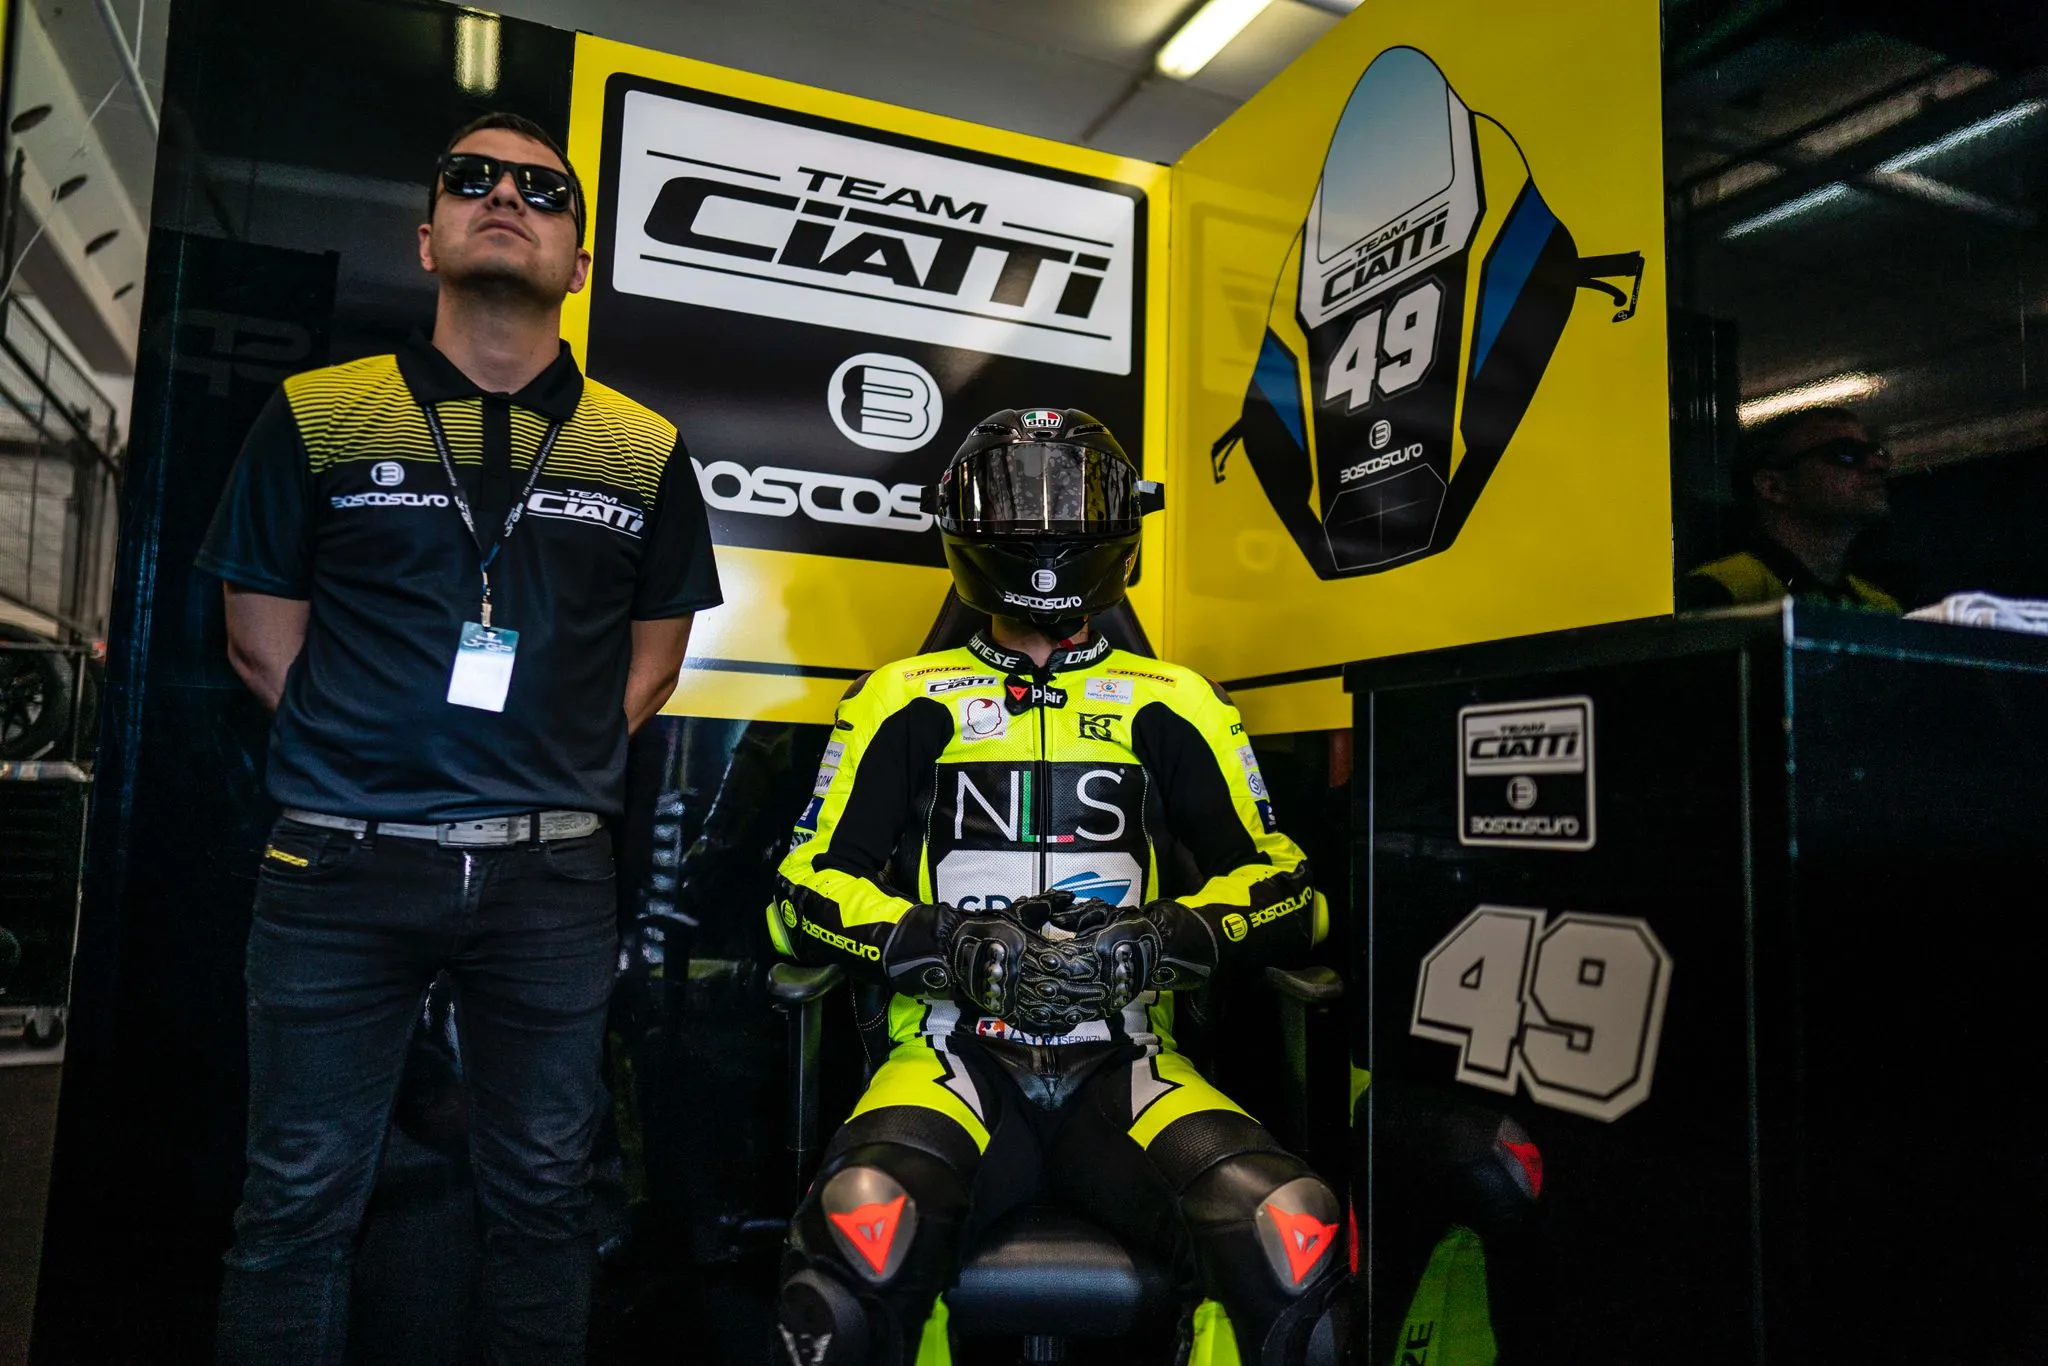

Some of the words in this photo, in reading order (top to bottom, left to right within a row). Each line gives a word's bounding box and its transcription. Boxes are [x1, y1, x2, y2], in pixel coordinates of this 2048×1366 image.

[797, 166, 989, 225] TEAM
[1355, 220, 1409, 256] TEAM
[1323, 280, 1443, 411] 49
[566, 489, 618, 504] TEAM
[916, 666, 973, 677] DUNLOP
[1119, 671, 1174, 683] DUNLOP
[1500, 722, 1545, 733] TEAM
[954, 769, 1126, 842] NLS
[1411, 906, 1673, 1121] 49
